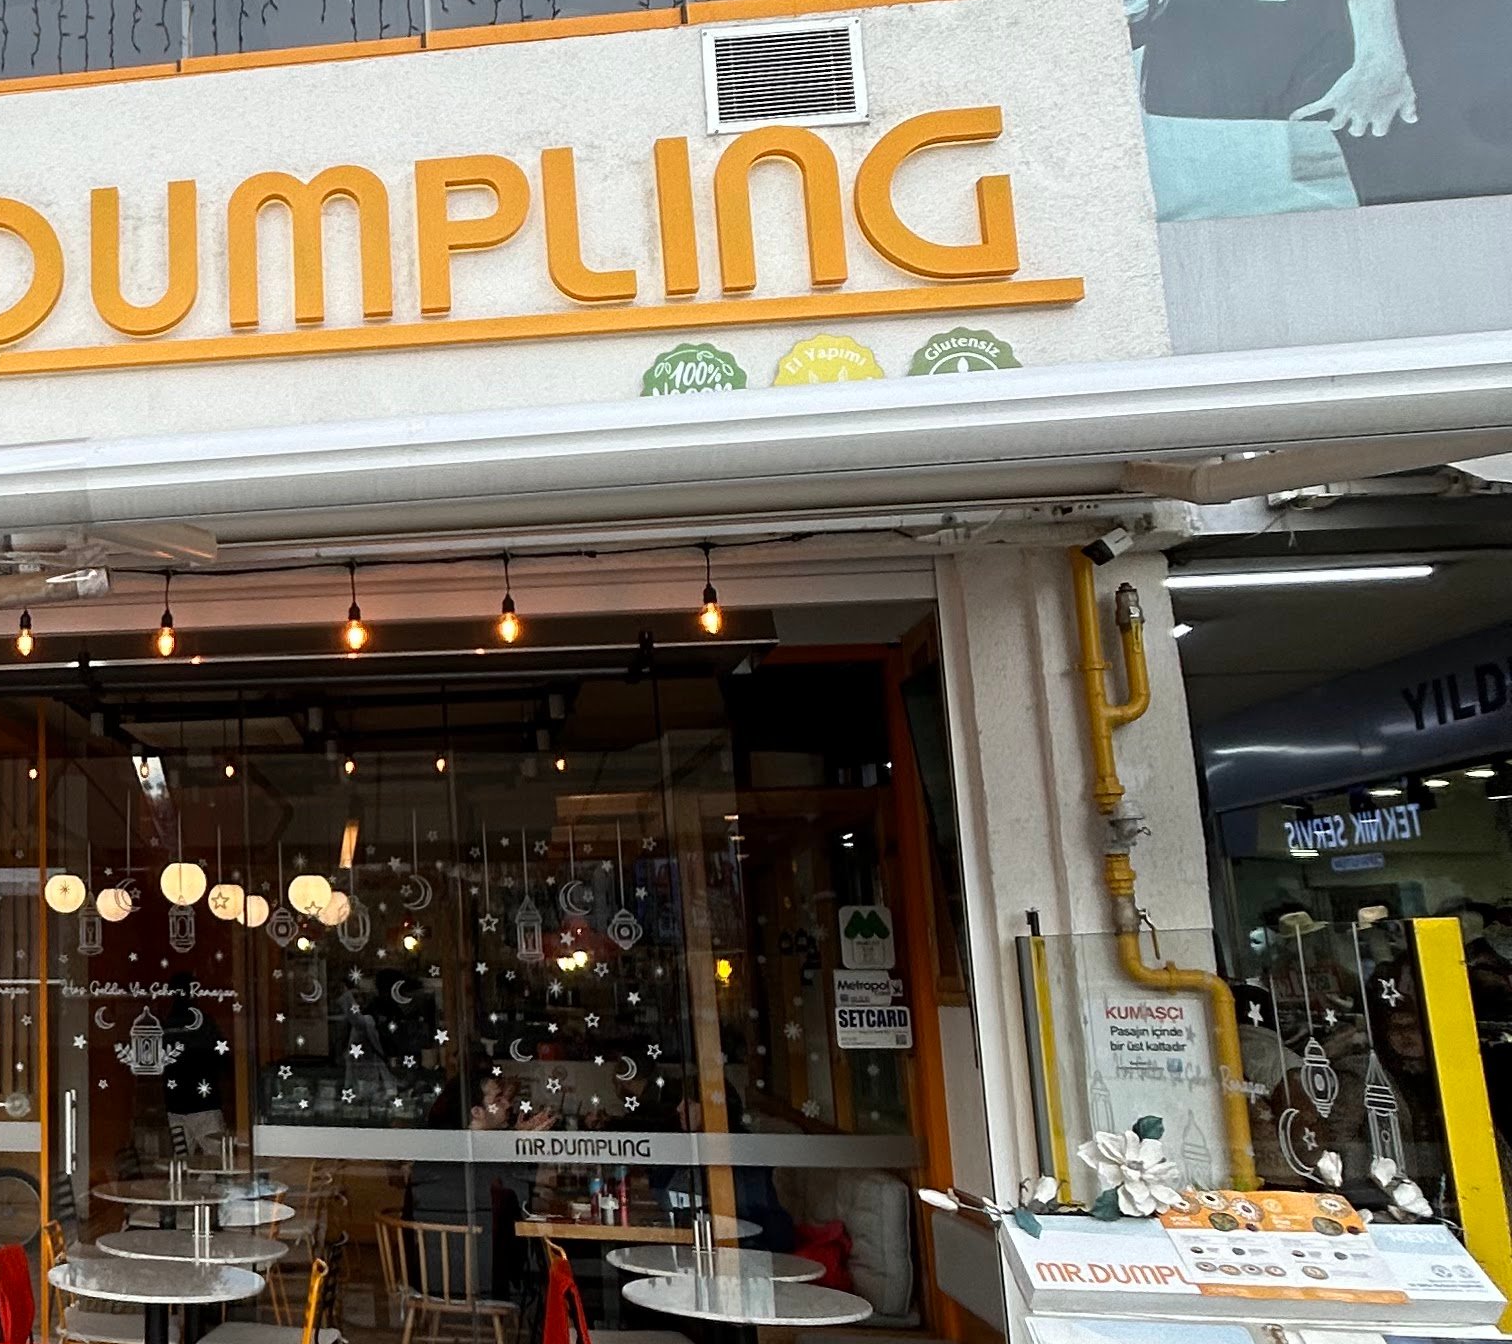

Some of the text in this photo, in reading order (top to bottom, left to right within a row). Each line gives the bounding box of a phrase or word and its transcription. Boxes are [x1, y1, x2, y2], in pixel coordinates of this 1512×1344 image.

[924, 337, 1000, 361] Glutensiz
[670, 360, 722, 387] 100%
[785, 359, 803, 375] El
[1402, 656, 1512, 731] YILD
[838, 1009, 909, 1029] SETCARD
[515, 1137, 651, 1158] MR.DUMPLING
